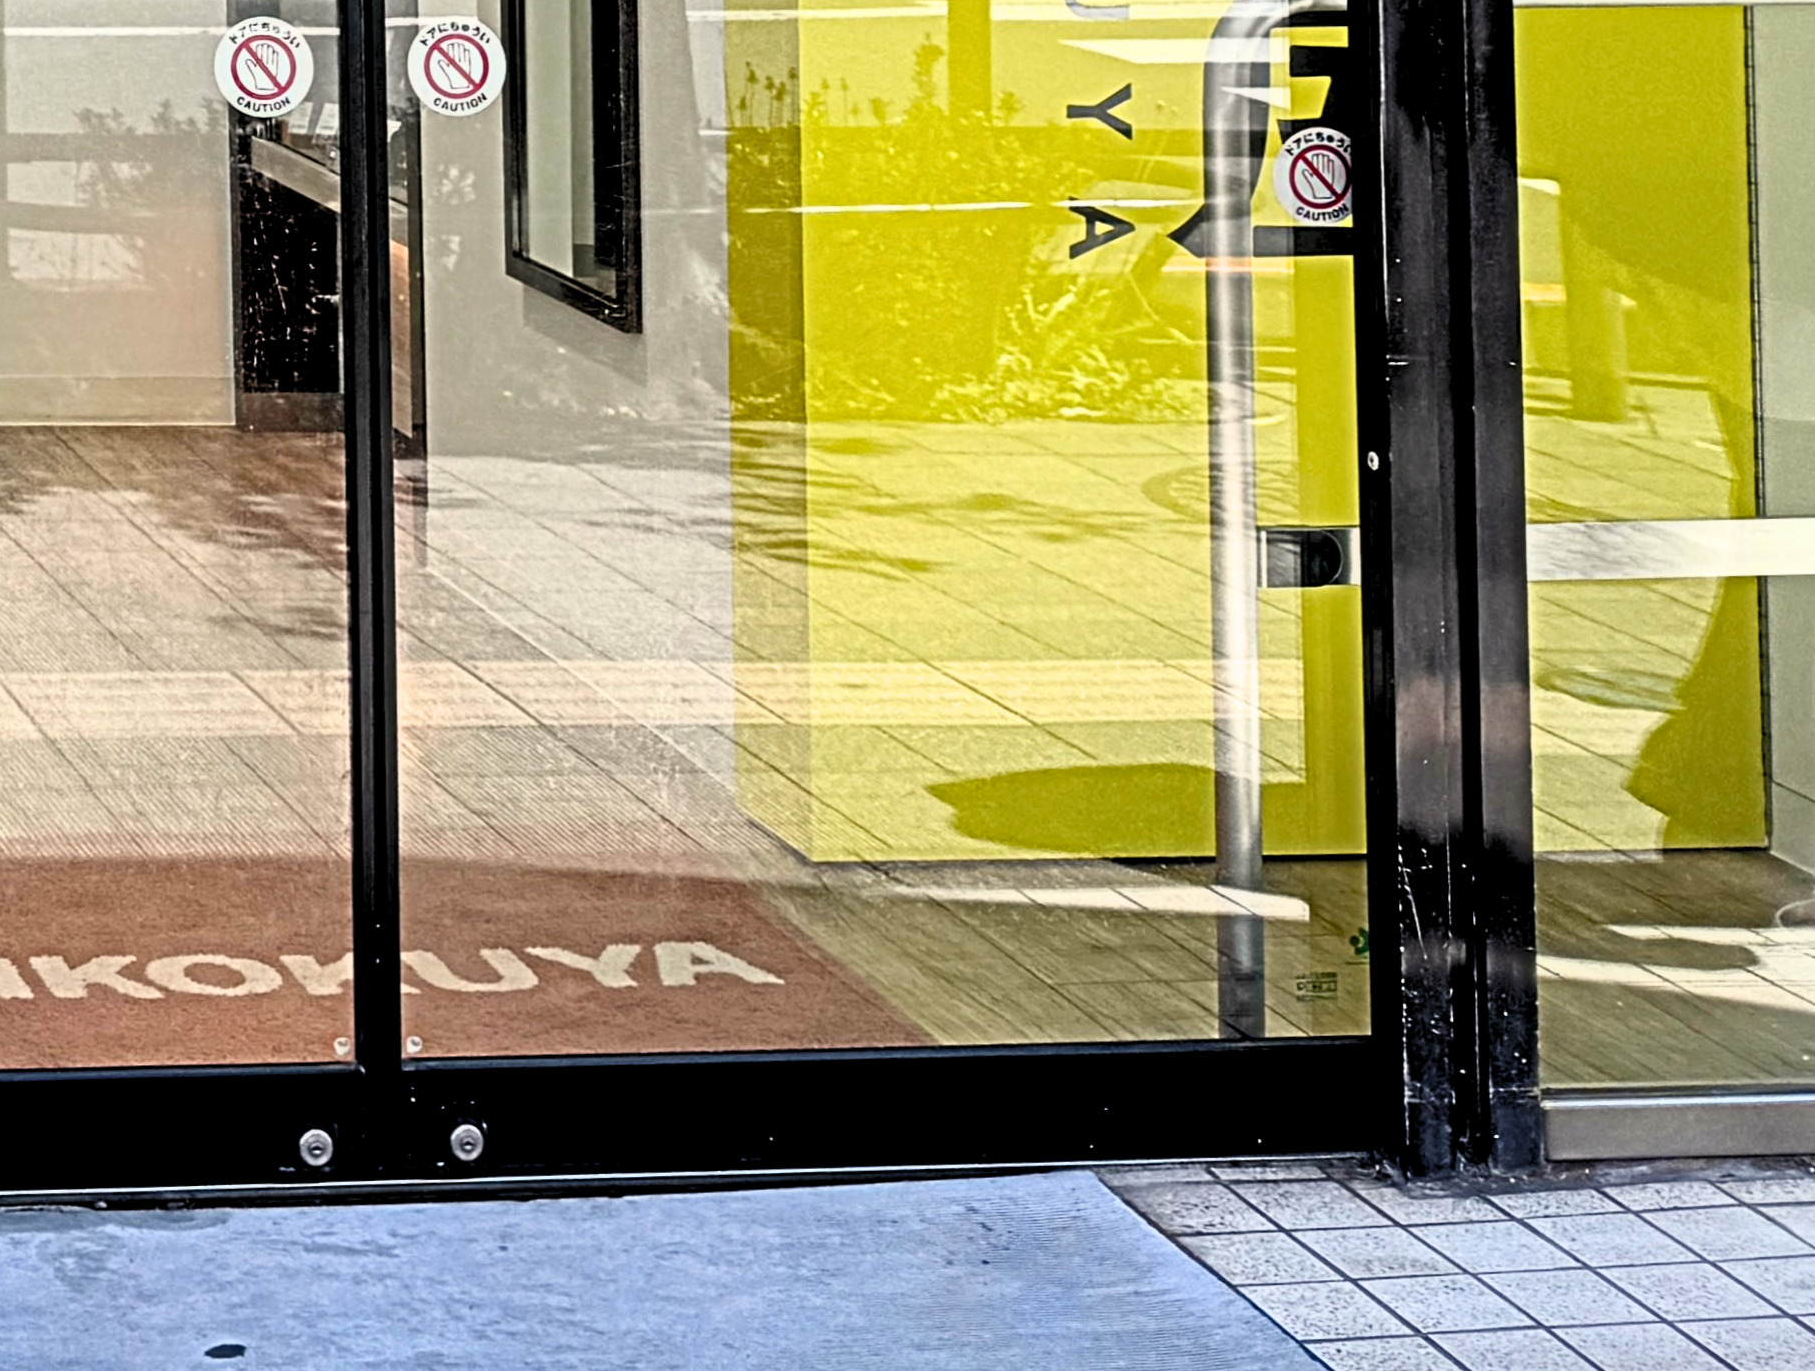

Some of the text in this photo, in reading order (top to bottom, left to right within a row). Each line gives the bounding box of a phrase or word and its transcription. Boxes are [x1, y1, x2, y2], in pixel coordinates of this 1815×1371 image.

[228, 22, 300, 49] ドアにちゅうい
[419, 21, 491, 47] ドアにちゅうい
[236, 96, 291, 112] CAUTION
[433, 95, 488, 112] CAUTION
[1296, 204, 1350, 221] CAUTION
